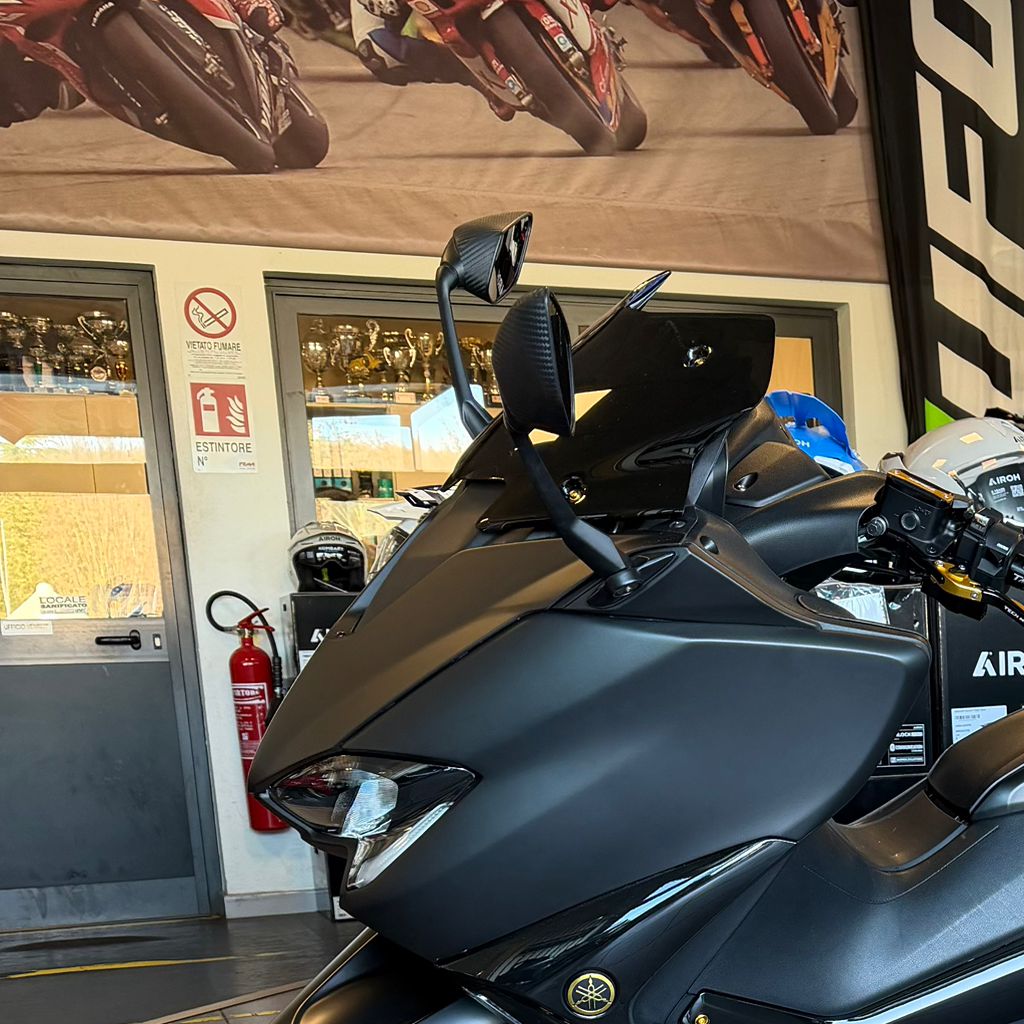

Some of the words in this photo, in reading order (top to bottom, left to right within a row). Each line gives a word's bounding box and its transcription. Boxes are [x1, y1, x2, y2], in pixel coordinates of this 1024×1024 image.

[186, 340, 212, 350] VIETATO
[213, 341, 241, 351] FUMARE
[195, 442, 252, 453] ESTINTORE
[988, 473, 1021, 486] AIROH
[40, 596, 86, 604] LOCALE
